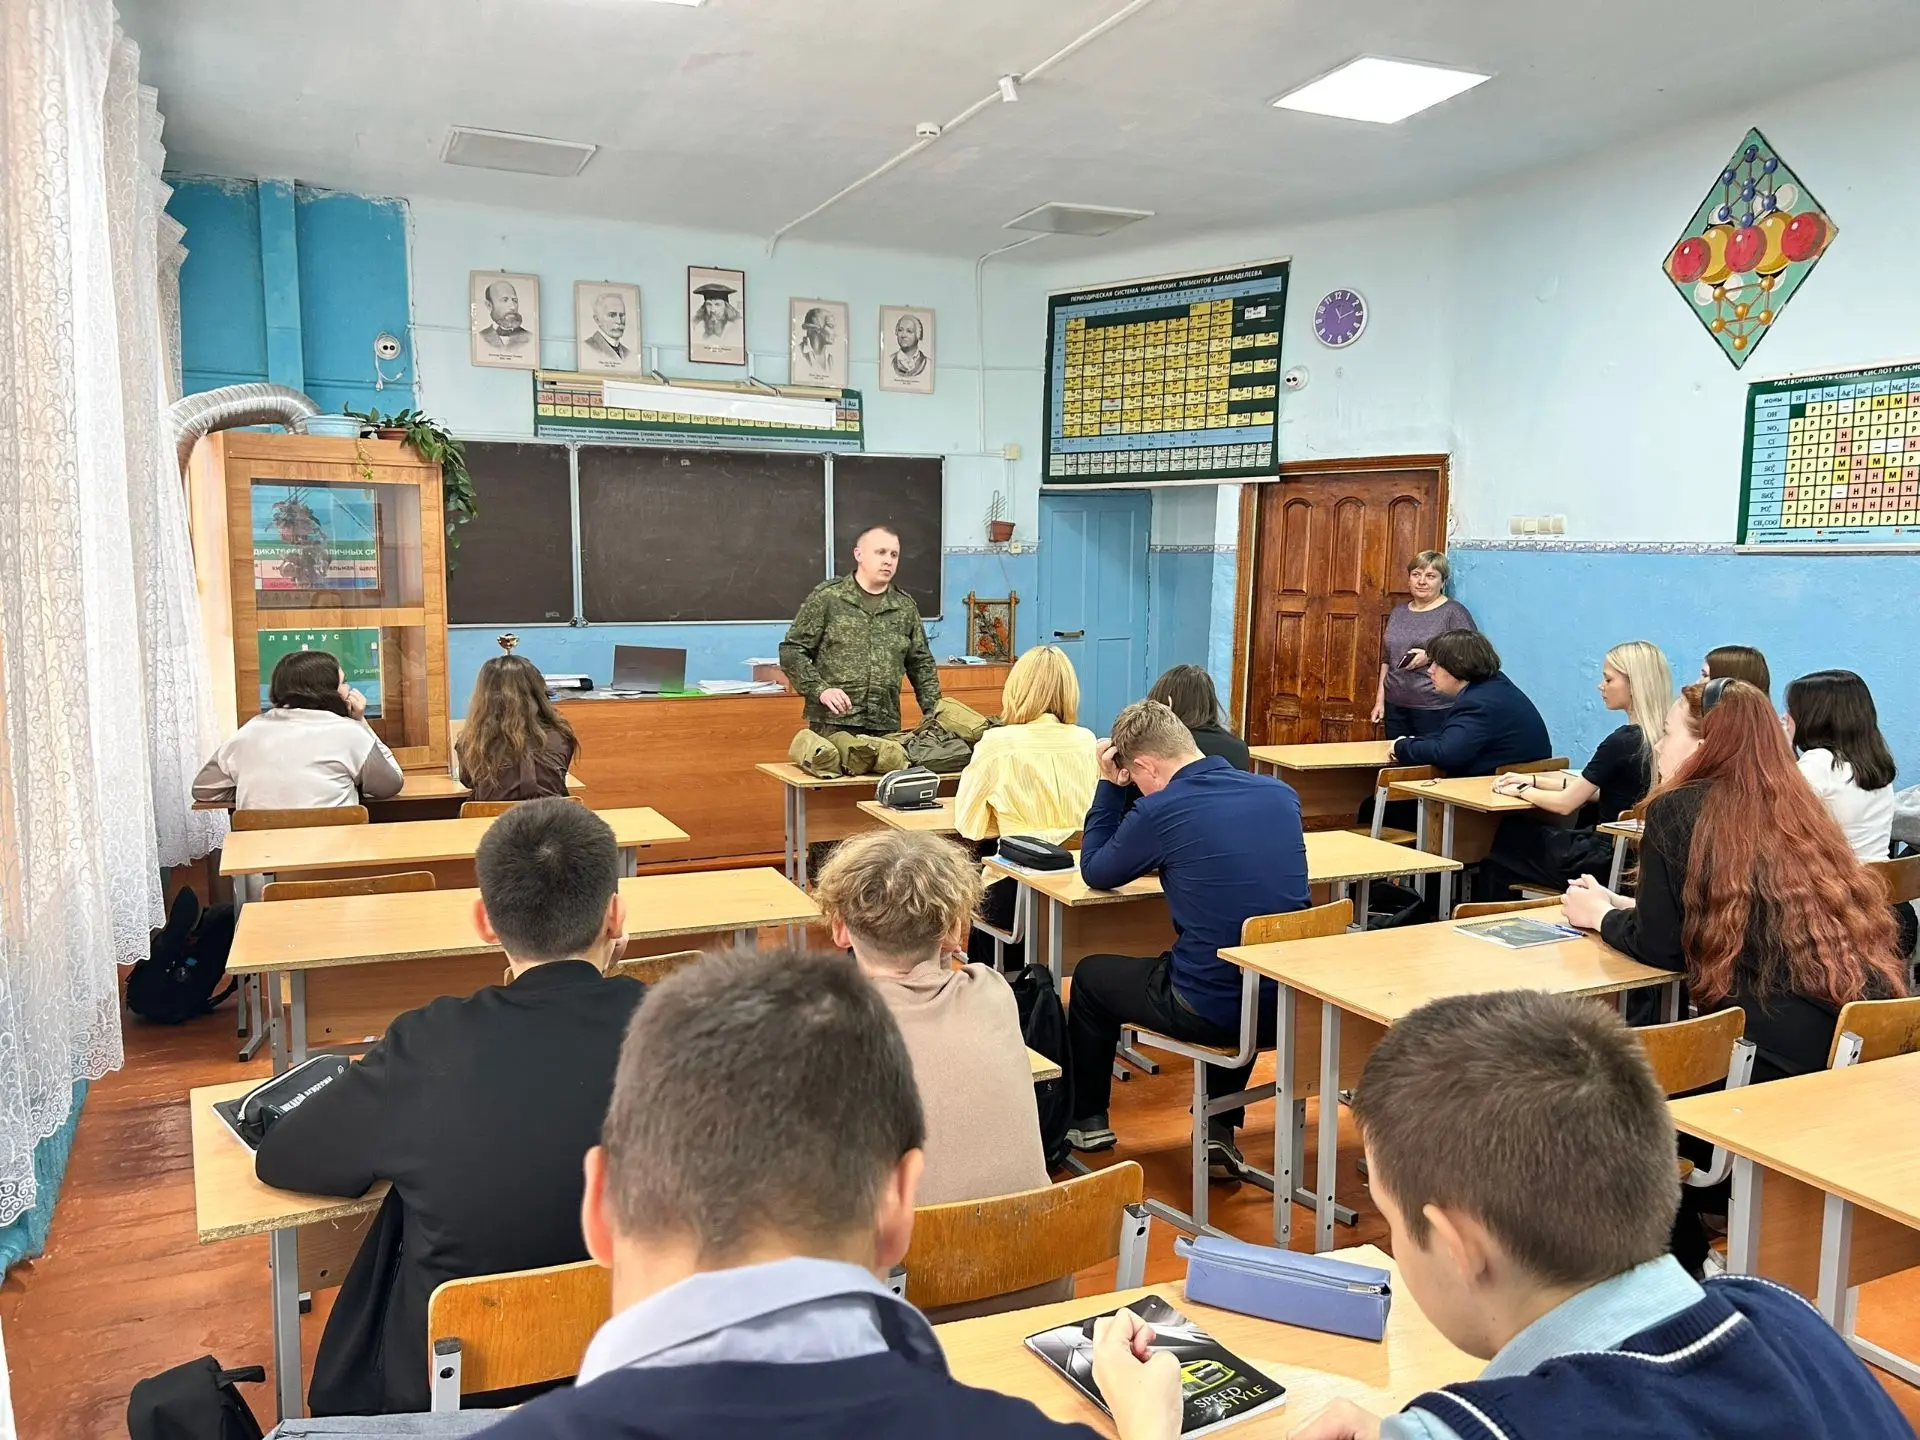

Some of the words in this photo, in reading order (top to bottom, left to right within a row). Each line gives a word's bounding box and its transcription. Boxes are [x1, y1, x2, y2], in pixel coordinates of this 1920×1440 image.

[1071, 292, 1113, 302] ПЕРИОДИЧЕСКАЯ
[1114, 288, 1139, 297] СИСТЕМА
[1179, 278, 1211, 287] ЭЛЕМЕНТОВ
[1325, 296, 1332, 304] 11
[1774, 375, 1833, 387] РАСТВОРИМОСТЬ
[1863, 368, 1893, 377] КИСЛОТ
[1194, 1387, 1241, 1408] SPEED
[1220, 1385, 1268, 1409] STYLE
